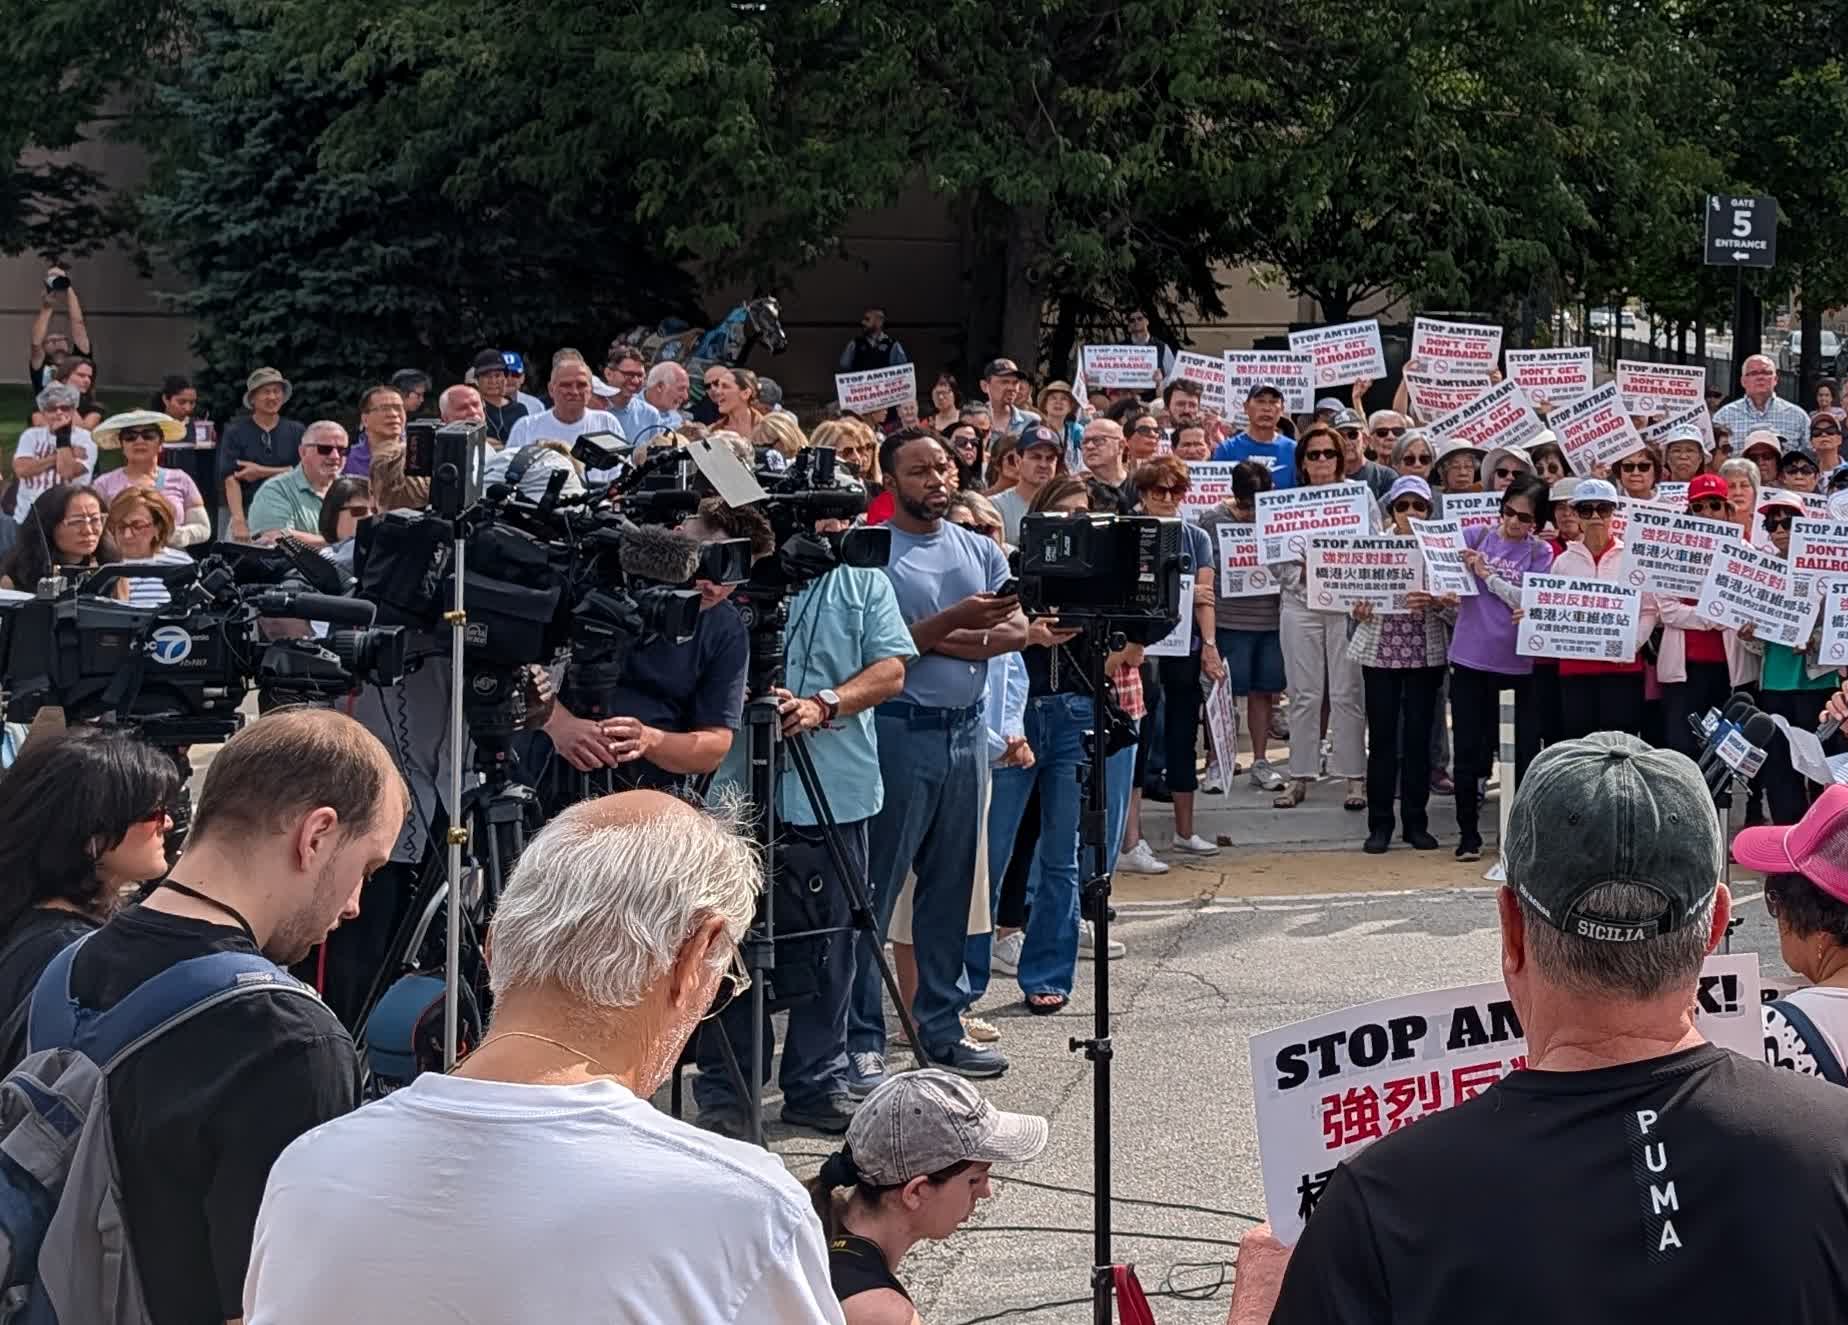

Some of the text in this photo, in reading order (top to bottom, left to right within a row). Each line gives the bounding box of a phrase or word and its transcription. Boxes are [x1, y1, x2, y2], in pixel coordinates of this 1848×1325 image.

[1731, 199, 1755, 208] GATE
[1732, 210, 1752, 237] 5
[1715, 238, 1767, 250] ENTRANCE
[1292, 324, 1376, 345] STOP AMTRAK!
[1417, 322, 1499, 338] STOP AMTRAK!
[1345, 340, 1367, 351] GET
[1426, 338, 1487, 350] DON'T GET
[1229, 354, 1312, 364] STOP AMTRAK!
[1418, 346, 1493, 359] RAILROADED
[1508, 351, 1590, 362] STOP AMTRAK!
[1519, 366, 1580, 376] DON'T GET
[1620, 364, 1704, 378] STOP AMTRAK!
[1407, 375, 1489, 387] STOP AMTRAK!
[1669, 379, 1691, 387] GET
[1623, 384, 1698, 397] RAILROADED
[1432, 381, 1516, 438] STOP AMTRAK!
[1489, 403, 1512, 420] GET
[1550, 386, 1617, 427] STOP AMTRAK!
[1564, 408, 1613, 439] DON'T GET
[1564, 416, 1625, 454] RAILROADED
[1201, 484, 1226, 492] GET
[1259, 486, 1365, 506] STOP AMTRAK!
[1446, 499, 1482, 509] STOP
[1273, 505, 1351, 521] DON'T GET
[1221, 528, 1253, 538] STOP
[1264, 515, 1361, 535] RAILROADED
[1634, 513, 1670, 527] STOP
[1673, 519, 1739, 538] AMTRAK!
[1795, 523, 1830, 535] STOP
[1312, 539, 1418, 550] STOP AMTRAK!
[1322, 552, 1408, 565] 強烈反對建立
[1721, 544, 1758, 564] STOP
[1316, 568, 1415, 581] 橋港火車維修站
[1529, 577, 1636, 597] STOP AMTRAK!
[1715, 574, 1811, 615] 橋港火車維修站
[1537, 592, 1623, 610] 強烈反對建立
[1529, 608, 1630, 626] 橋港火車維修站
[1577, 920, 1646, 942] SICILIA
[1276, 1015, 1427, 1090] STOP
[1636, 1109, 1682, 1252] PUMA
